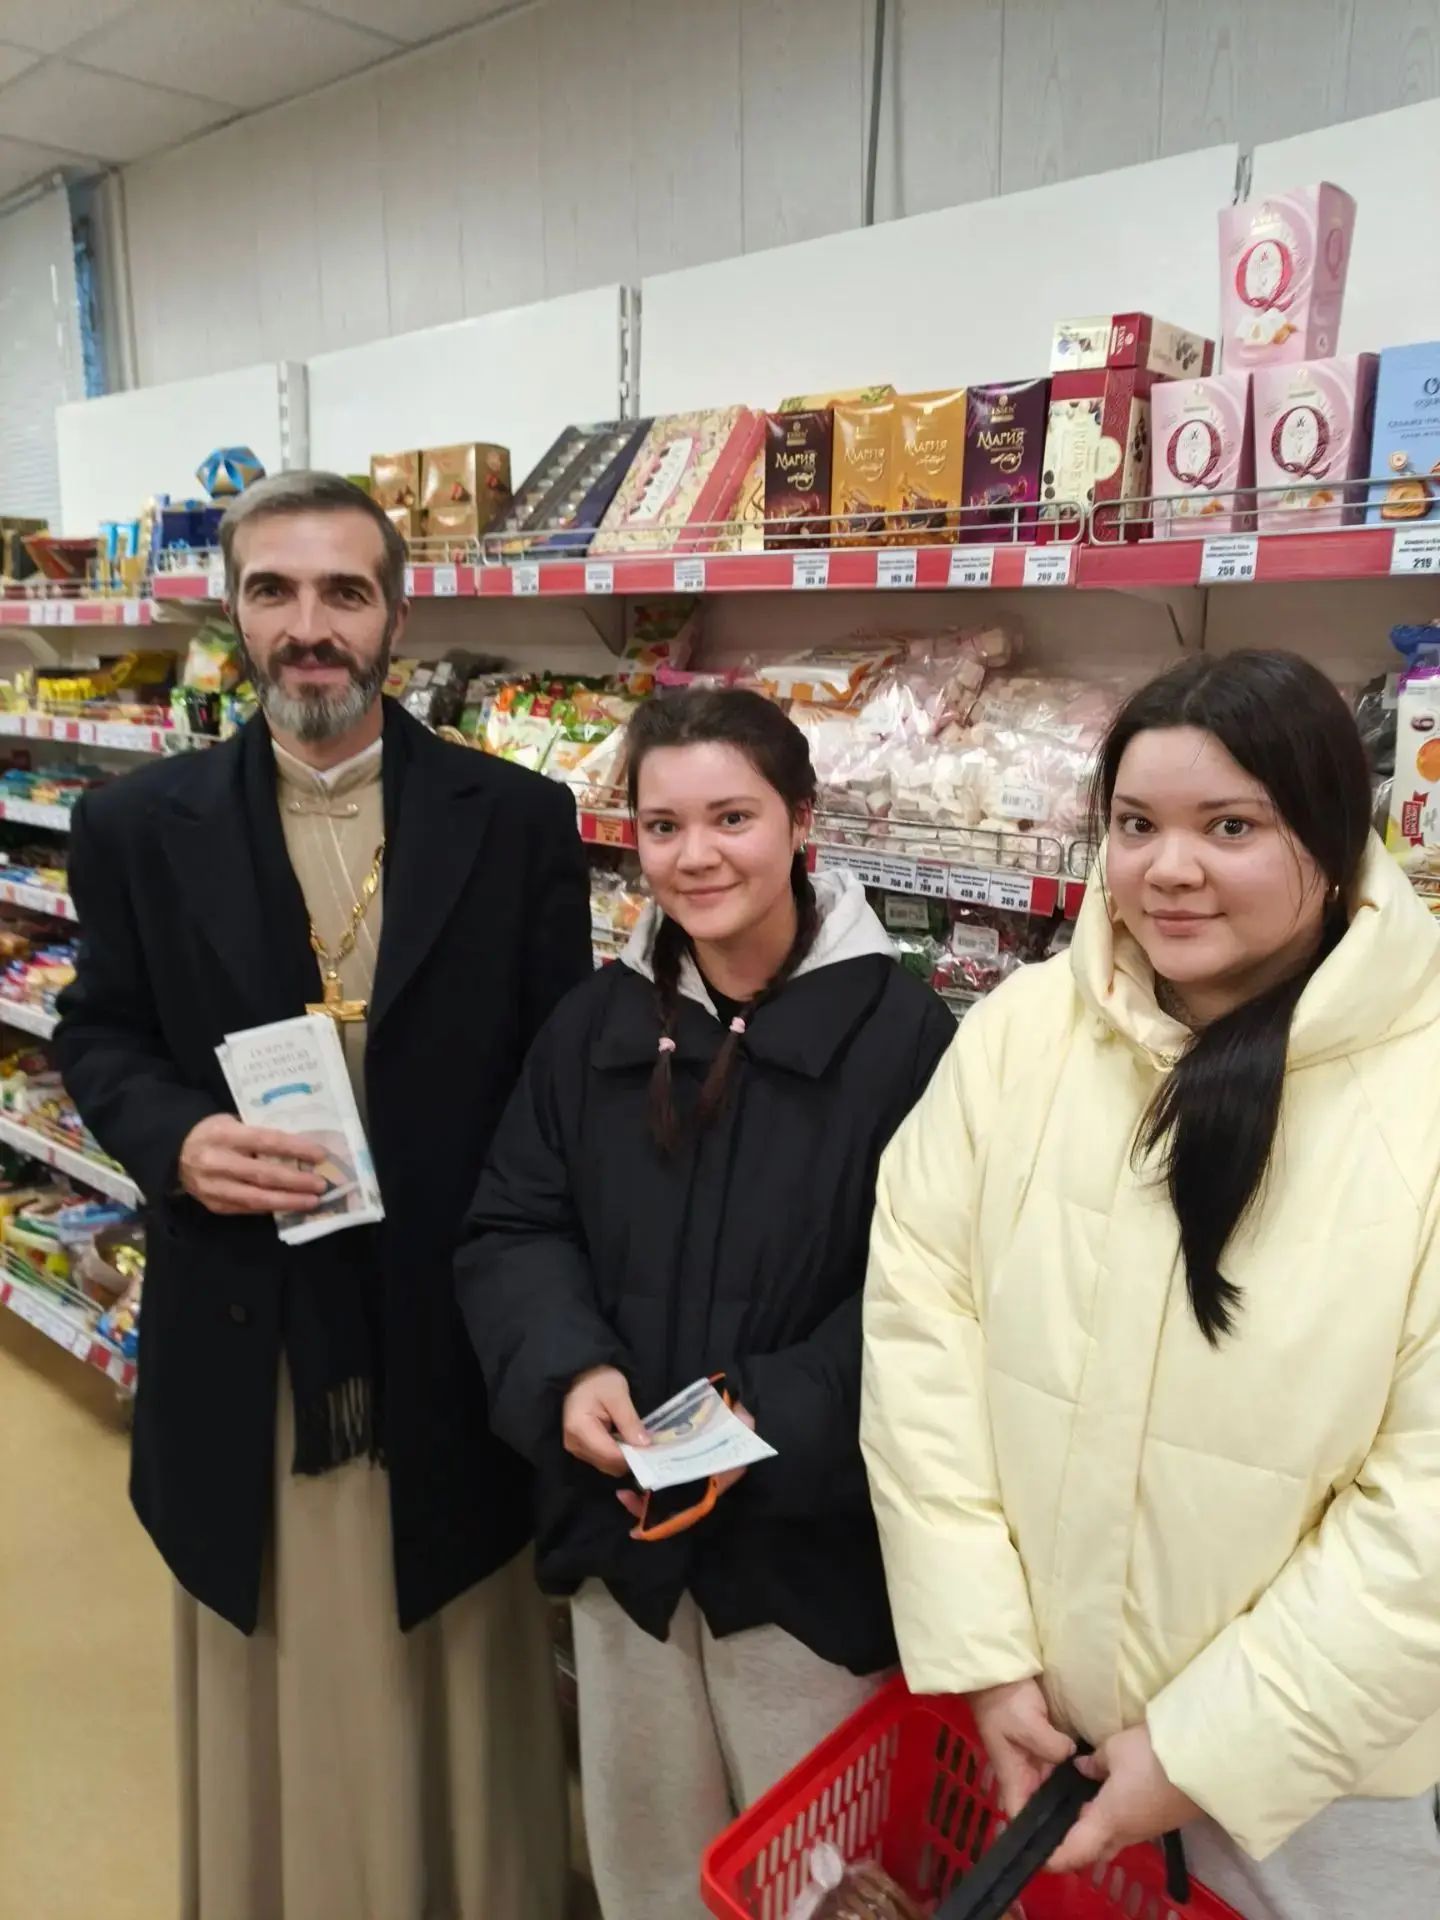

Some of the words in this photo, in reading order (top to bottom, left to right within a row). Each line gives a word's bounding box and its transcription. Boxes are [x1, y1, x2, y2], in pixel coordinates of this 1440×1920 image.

[1236, 239, 1297, 312] Q
[1167, 419, 1223, 489] Q
[1271, 405, 1332, 480] Q
[1240, 564, 1252, 575] 00
